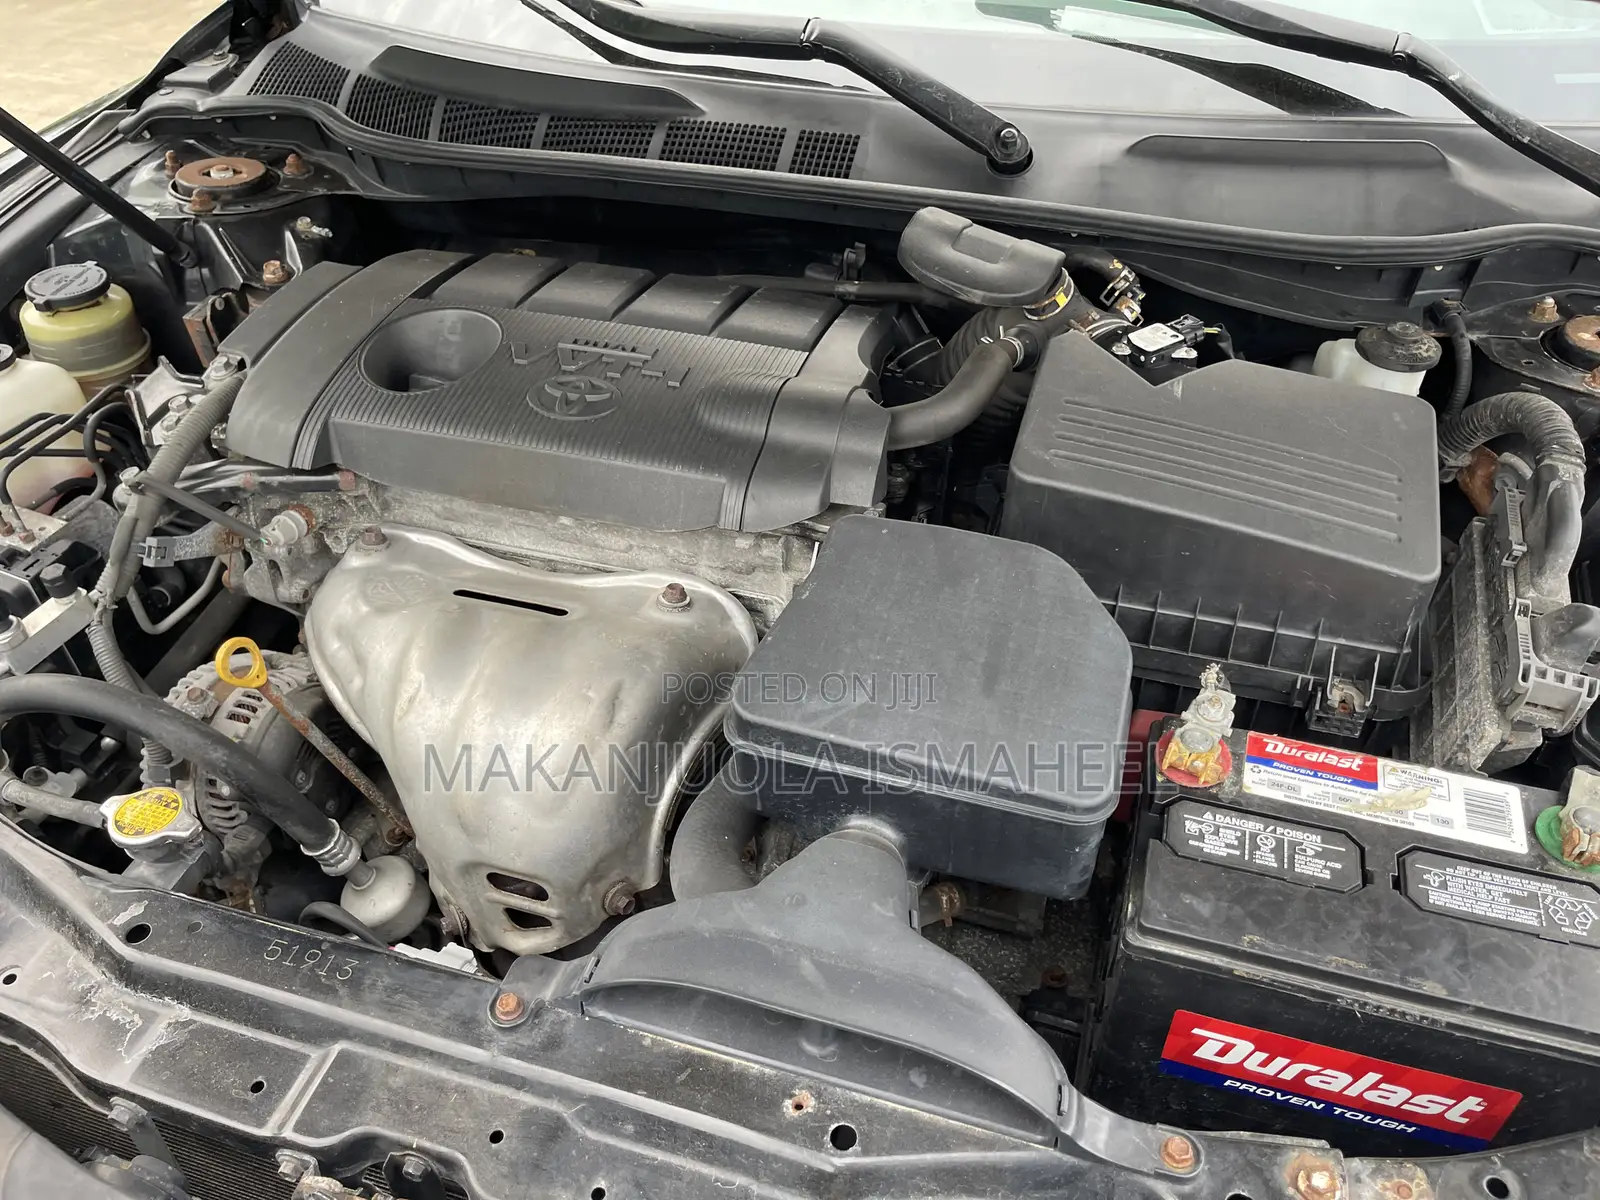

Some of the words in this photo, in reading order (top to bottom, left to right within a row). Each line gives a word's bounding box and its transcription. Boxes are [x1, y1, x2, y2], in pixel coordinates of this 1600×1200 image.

[1263, 738, 1364, 771] Duralast
[1272, 762, 1315, 776] PROVEN
[1316, 772, 1354, 784] TOUGH
[1270, 782, 1298, 792] 24F-DL
[1216, 814, 1264, 832] DANGER
[1276, 826, 1321, 844] POISON
[1446, 875, 1466, 884] FLUSH
[1467, 880, 1484, 888] EYES
[1484, 883, 1528, 897] IMMEDIATELY
[1447, 881, 1464, 890] WITH
[1448, 886, 1476, 897] MEDICAL
[264, 939, 360, 980] 51913
[1190, 1028, 1483, 1124] Duralast
[1222, 1079, 1326, 1110] PROVEN
[1331, 1106, 1418, 1134] TOUGH
